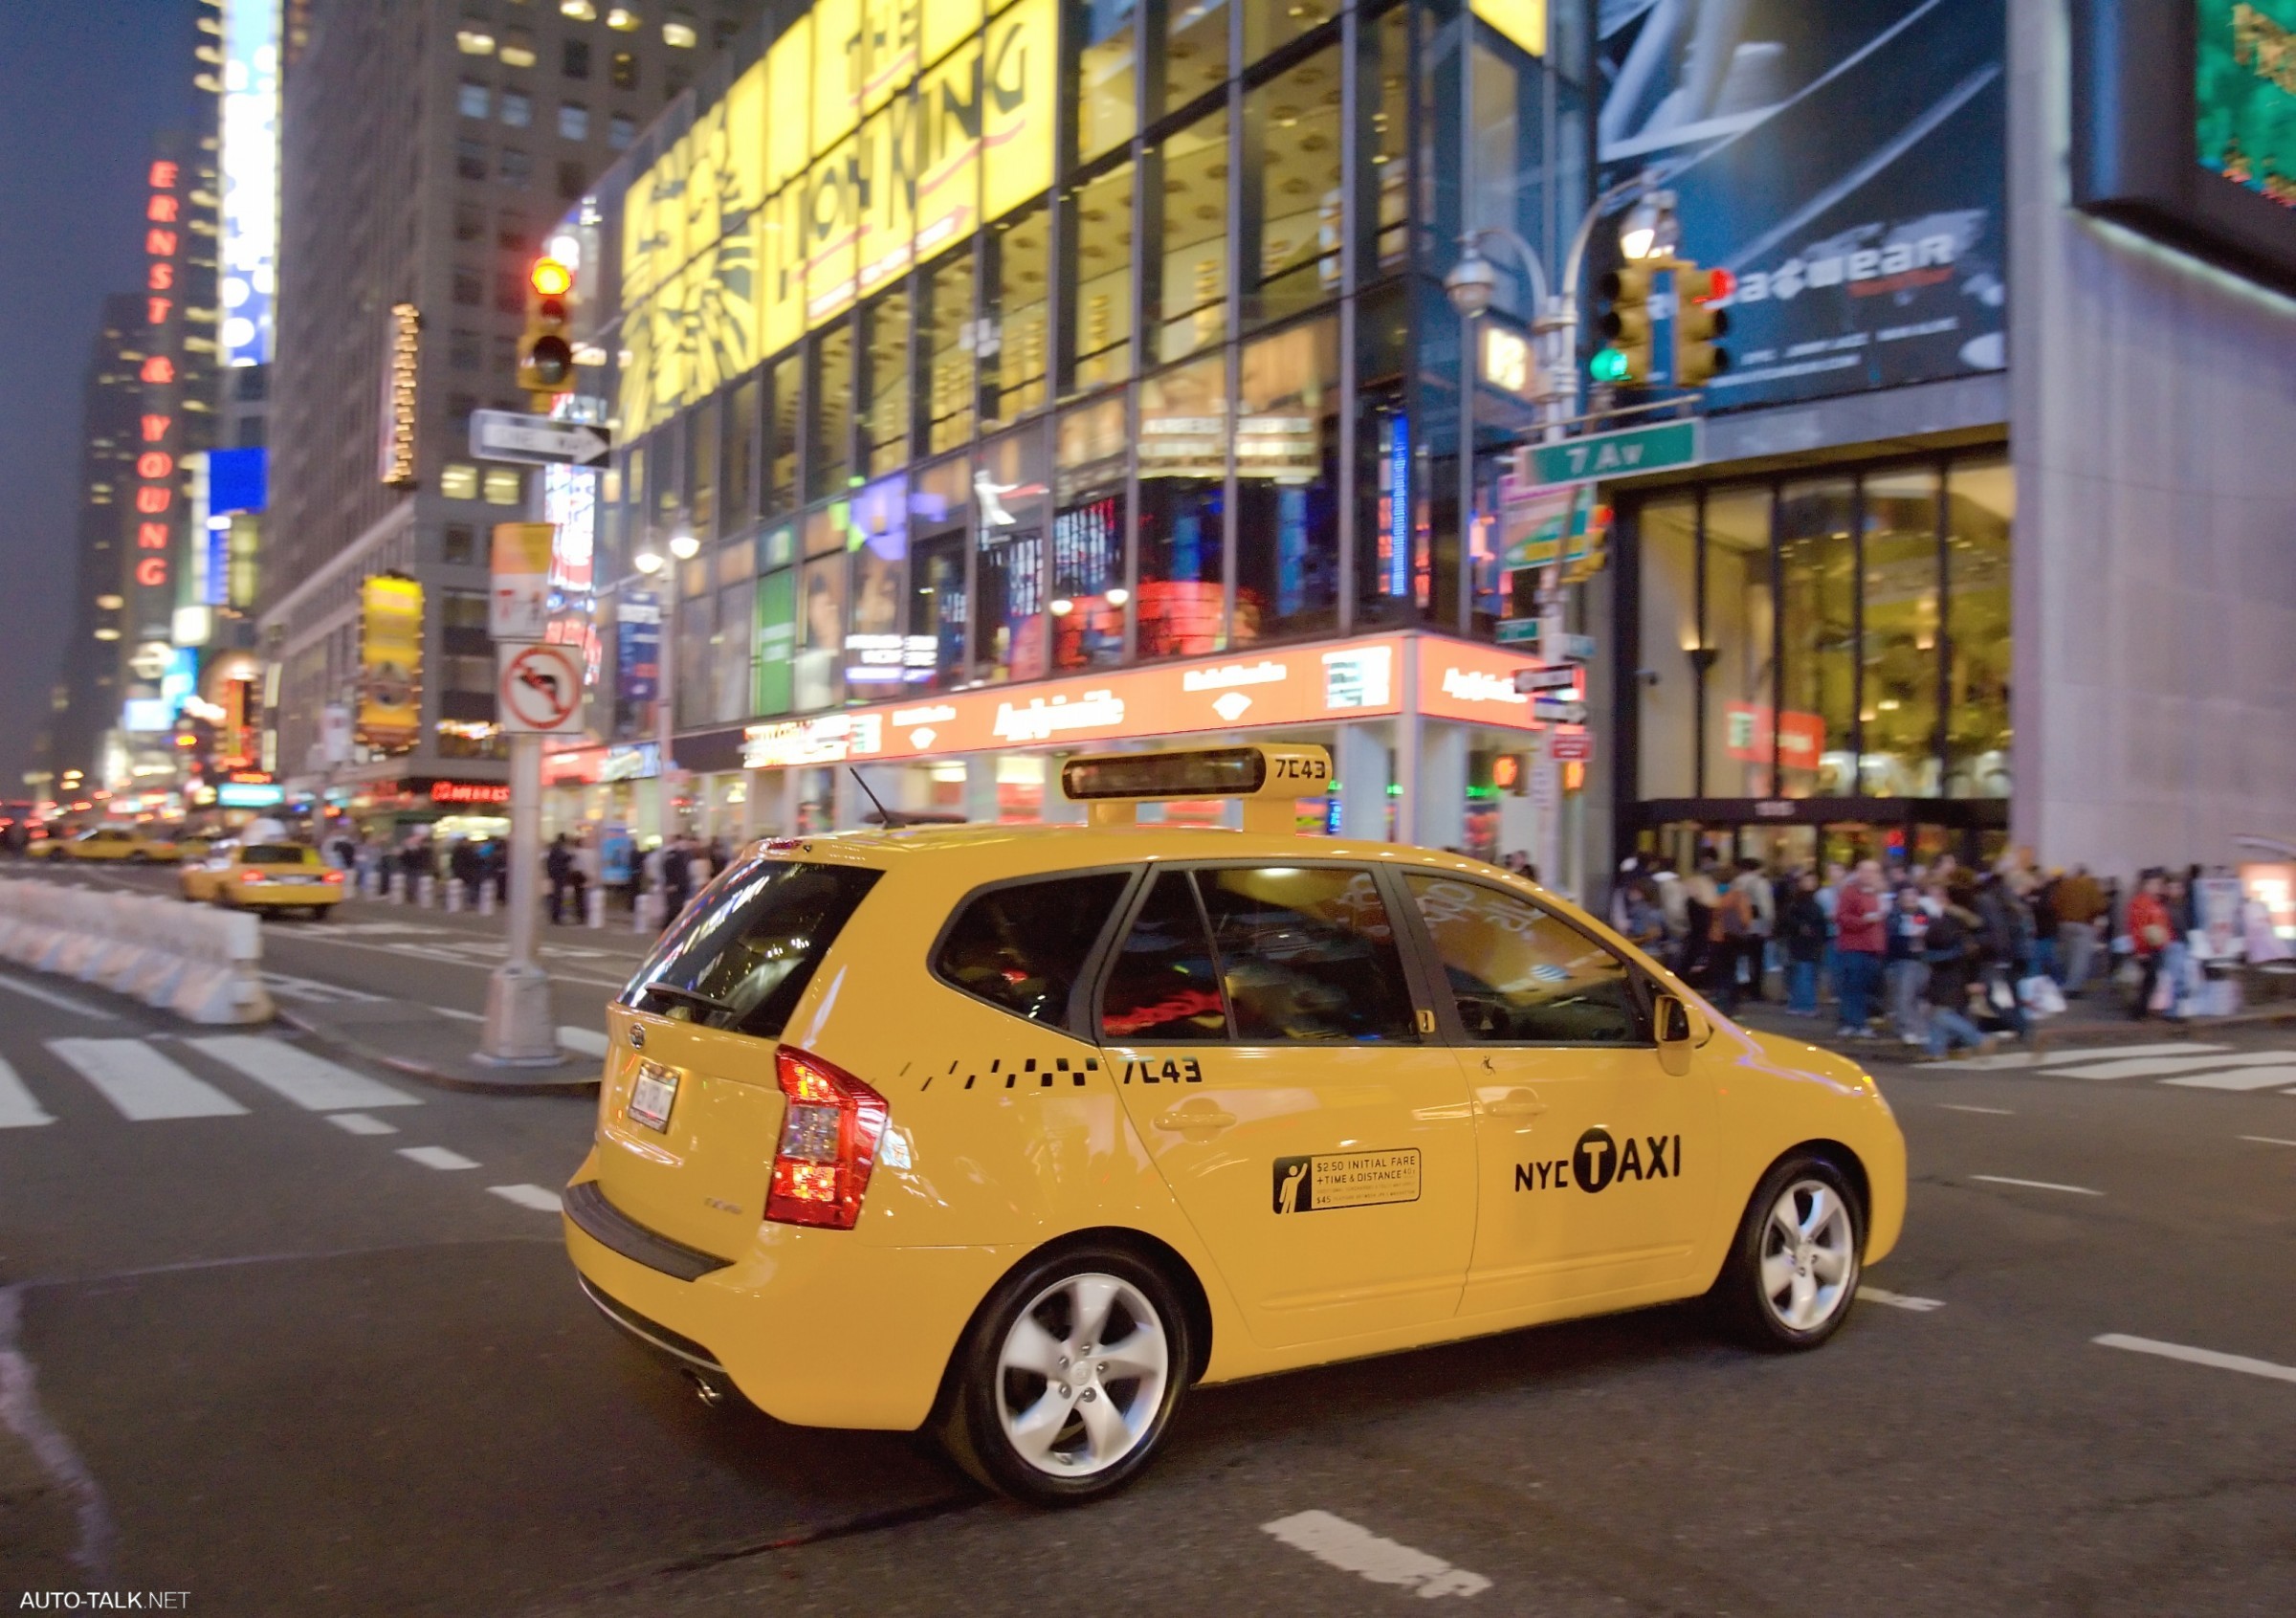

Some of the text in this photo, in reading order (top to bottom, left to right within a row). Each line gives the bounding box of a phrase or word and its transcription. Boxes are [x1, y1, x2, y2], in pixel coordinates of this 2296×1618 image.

[885, 23, 1026, 232] KING
[147, 160, 179, 324] ERNST
[1566, 444, 1591, 475] 7
[137, 412, 173, 587] YOUNG
[1274, 758, 1326, 780] 7C43
[1117, 1055, 1203, 1085] 7C43
[1348, 1158, 1386, 1169] INITIAL
[1391, 1155, 1415, 1165] FARE
[1350, 1174, 1355, 1183] &
[1357, 1169, 1402, 1182] DISTANCE
[1514, 1132, 1681, 1193] NYC TAXI
[1316, 1195, 1332, 1205] $45
